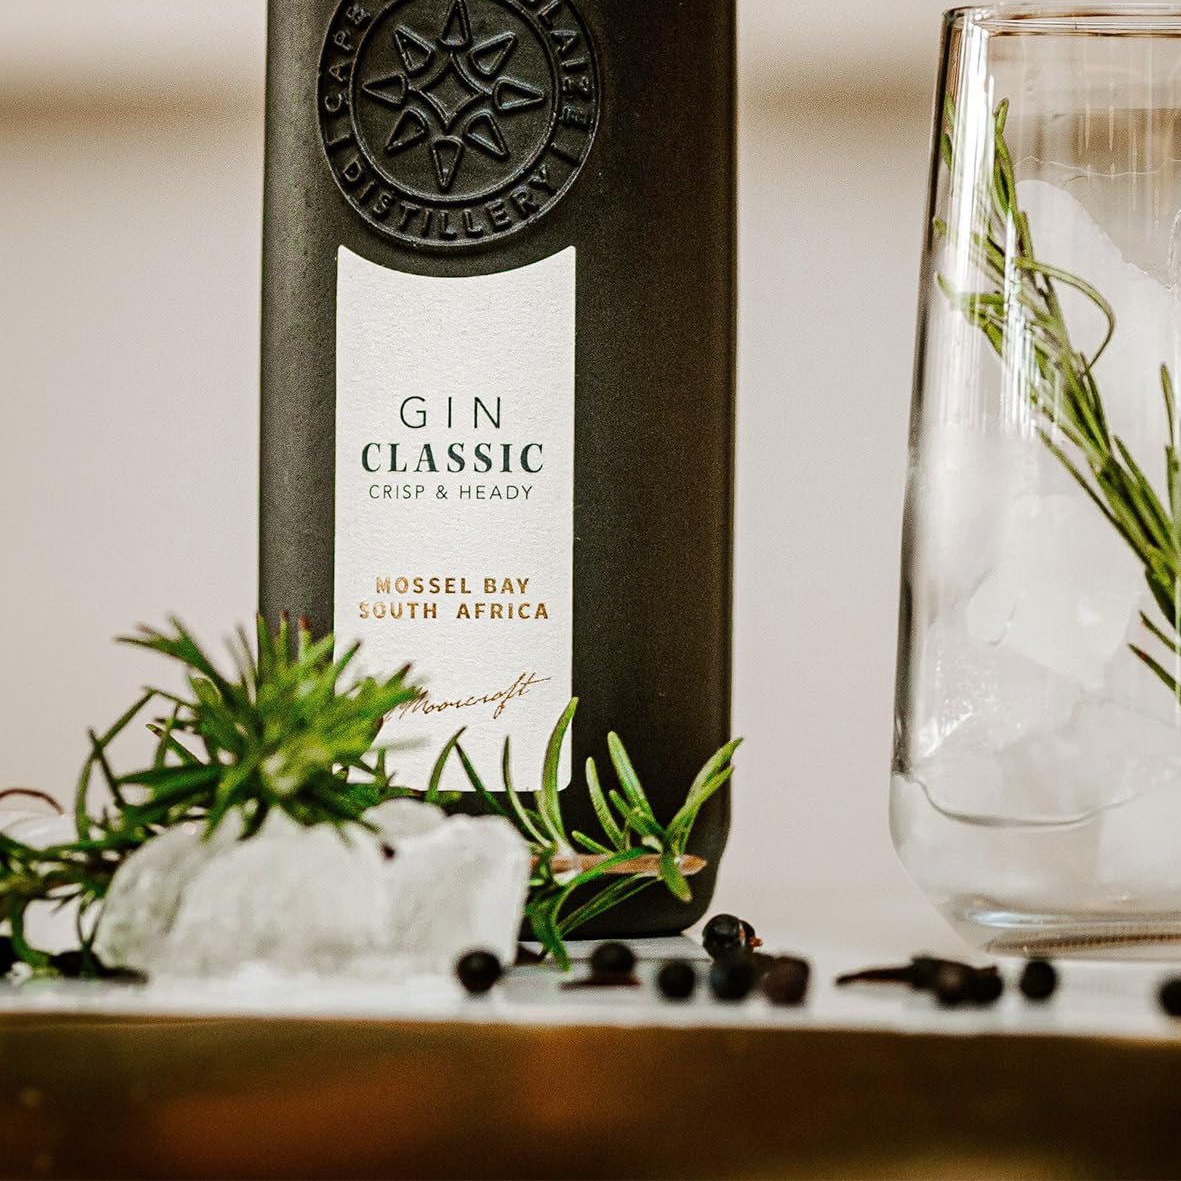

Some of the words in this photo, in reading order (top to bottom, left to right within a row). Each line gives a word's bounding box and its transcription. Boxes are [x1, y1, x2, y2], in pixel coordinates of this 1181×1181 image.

[325, 4, 371, 113] CAPE
[343, 164, 559, 240] DISTILLERY
[400, 396, 501, 429] GIN
[361, 442, 543, 472] CLASSIC
[369, 484, 425, 499] CRISP
[435, 484, 448, 499] &
[459, 485, 533, 499] HEADY
[376, 577, 471, 594] MOSSEL
[483, 577, 529, 594] BAY
[359, 602, 437, 619] SOUTH
[456, 602, 549, 619] AFRICA
